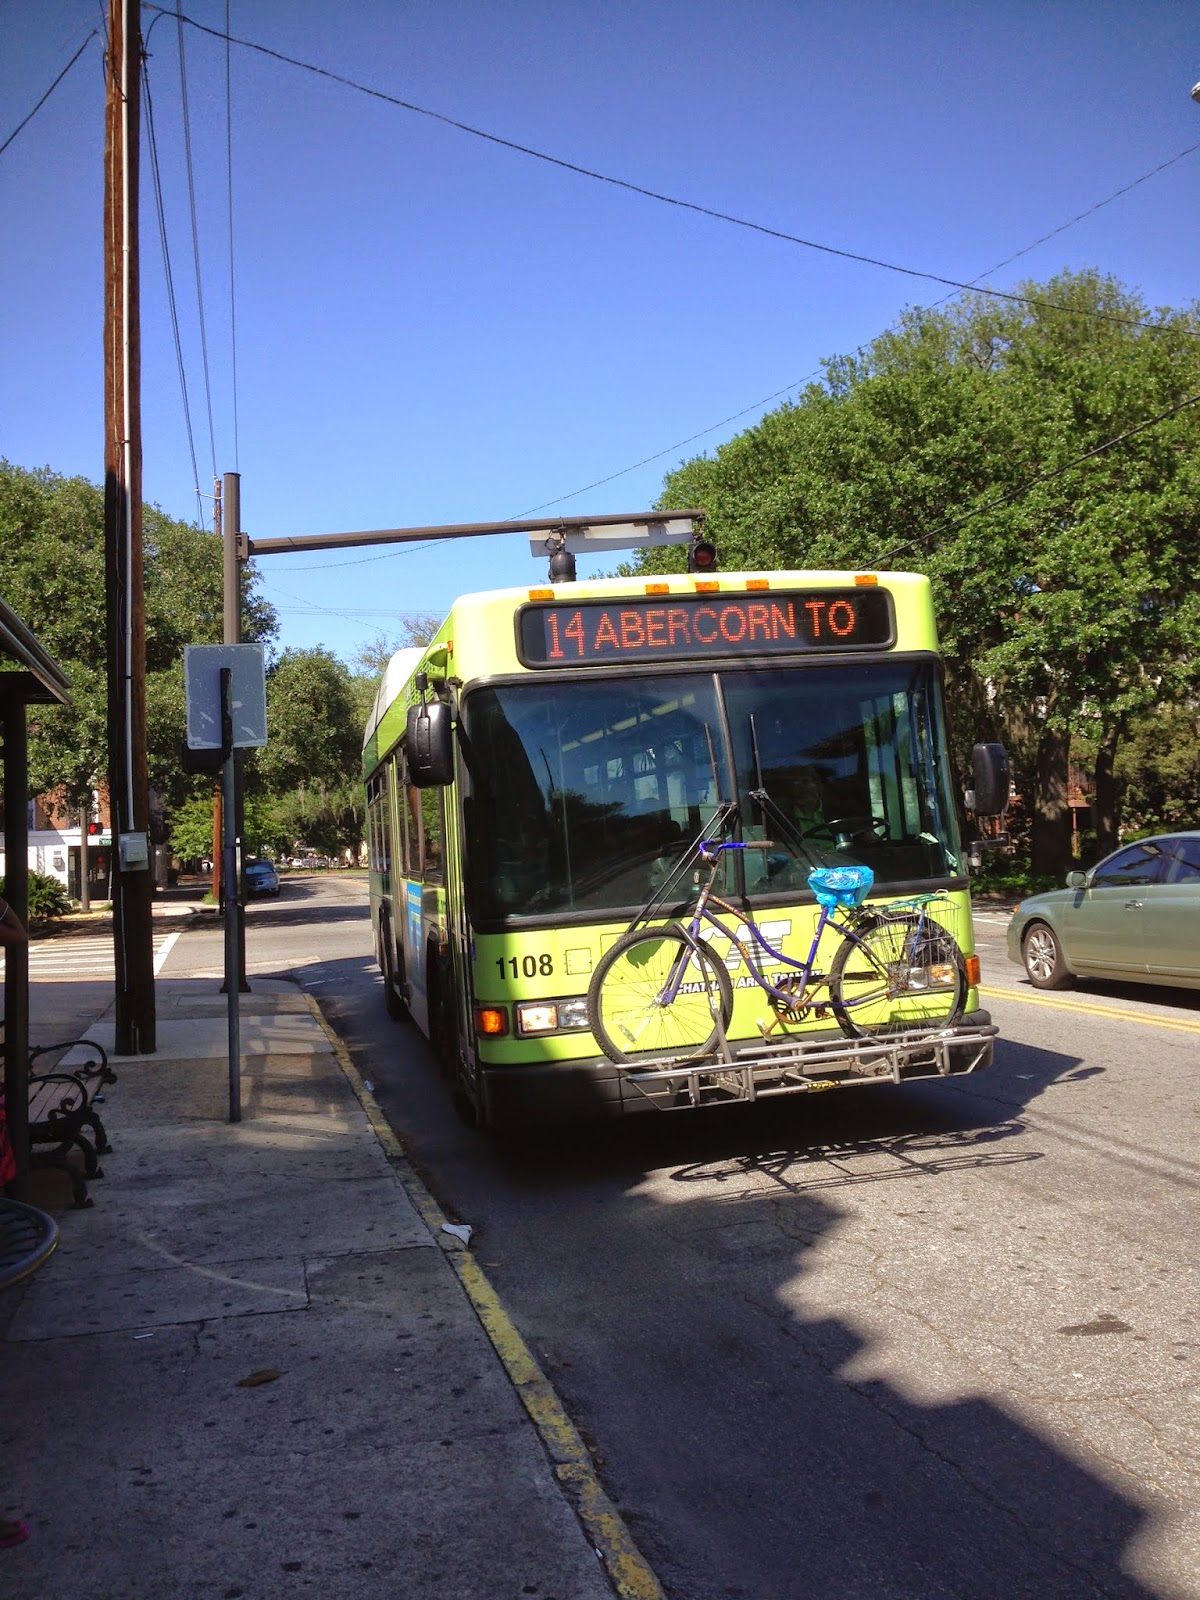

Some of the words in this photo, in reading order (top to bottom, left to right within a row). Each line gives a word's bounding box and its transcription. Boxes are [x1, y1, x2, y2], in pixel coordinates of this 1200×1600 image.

[547, 611, 585, 658] 14
[594, 602, 796, 650] ABERCORN
[805, 600, 855, 637] TO
[496, 953, 554, 979] 1108
[691, 919, 792, 973] CAT
[676, 978, 735, 995] CHATH
[771, 968, 822, 987] TRANIT
